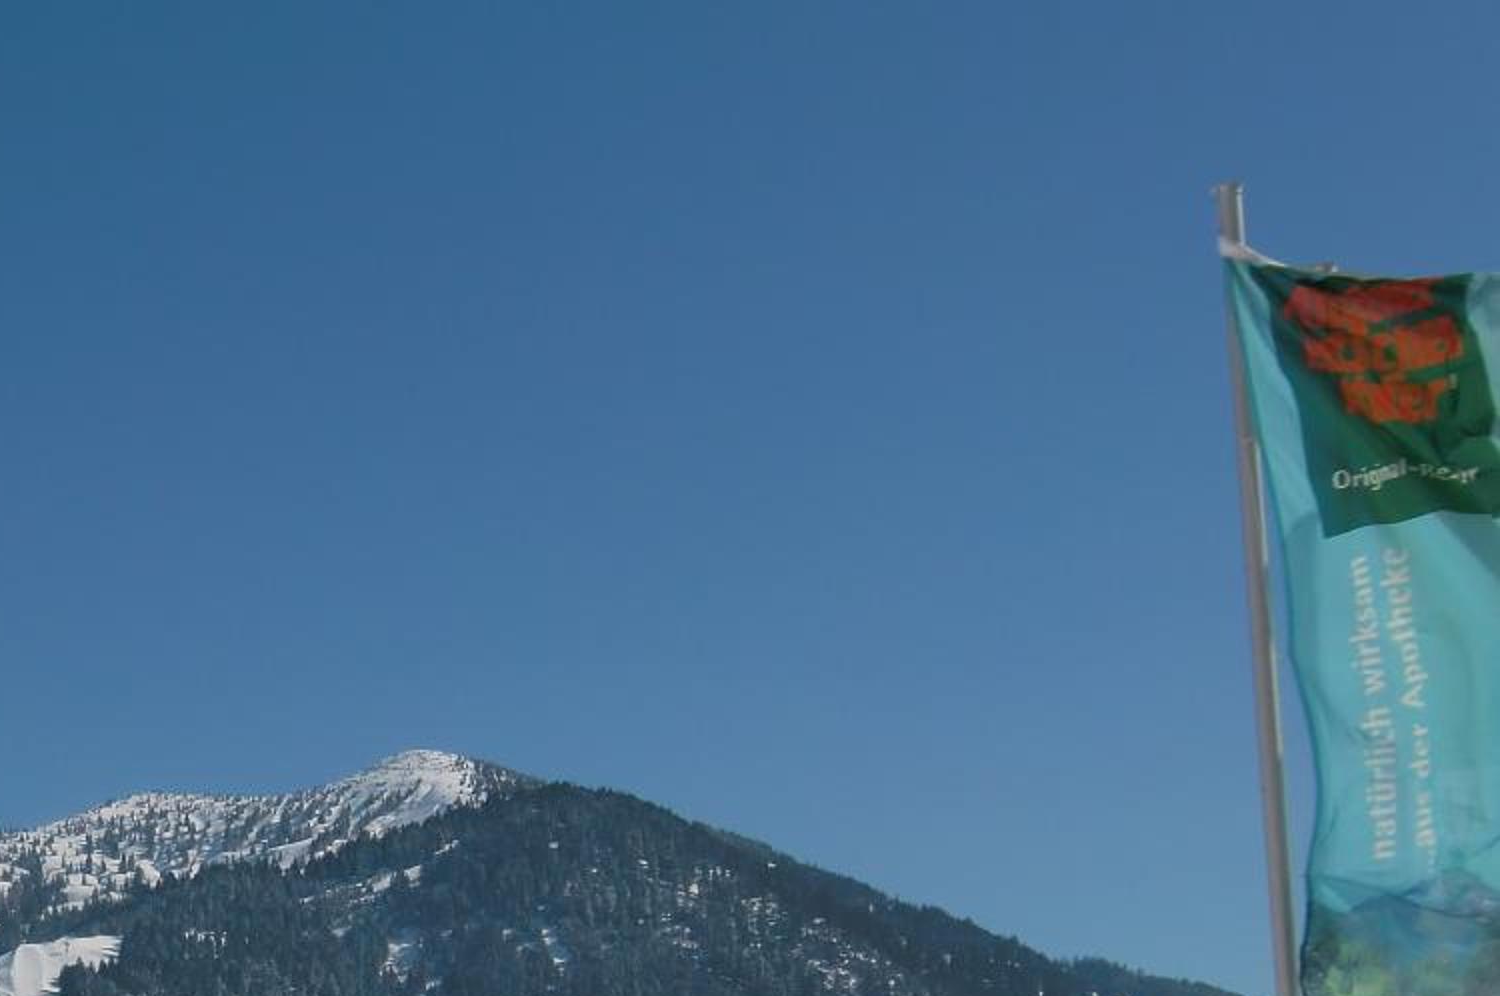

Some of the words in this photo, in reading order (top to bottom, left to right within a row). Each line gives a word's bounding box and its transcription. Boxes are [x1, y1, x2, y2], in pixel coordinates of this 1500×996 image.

[1348, 555, 1387, 696] wirksam
[1379, 546, 1429, 709] Apotheke
[1358, 706, 1398, 861] natürlich
[1408, 723, 1431, 778] der
